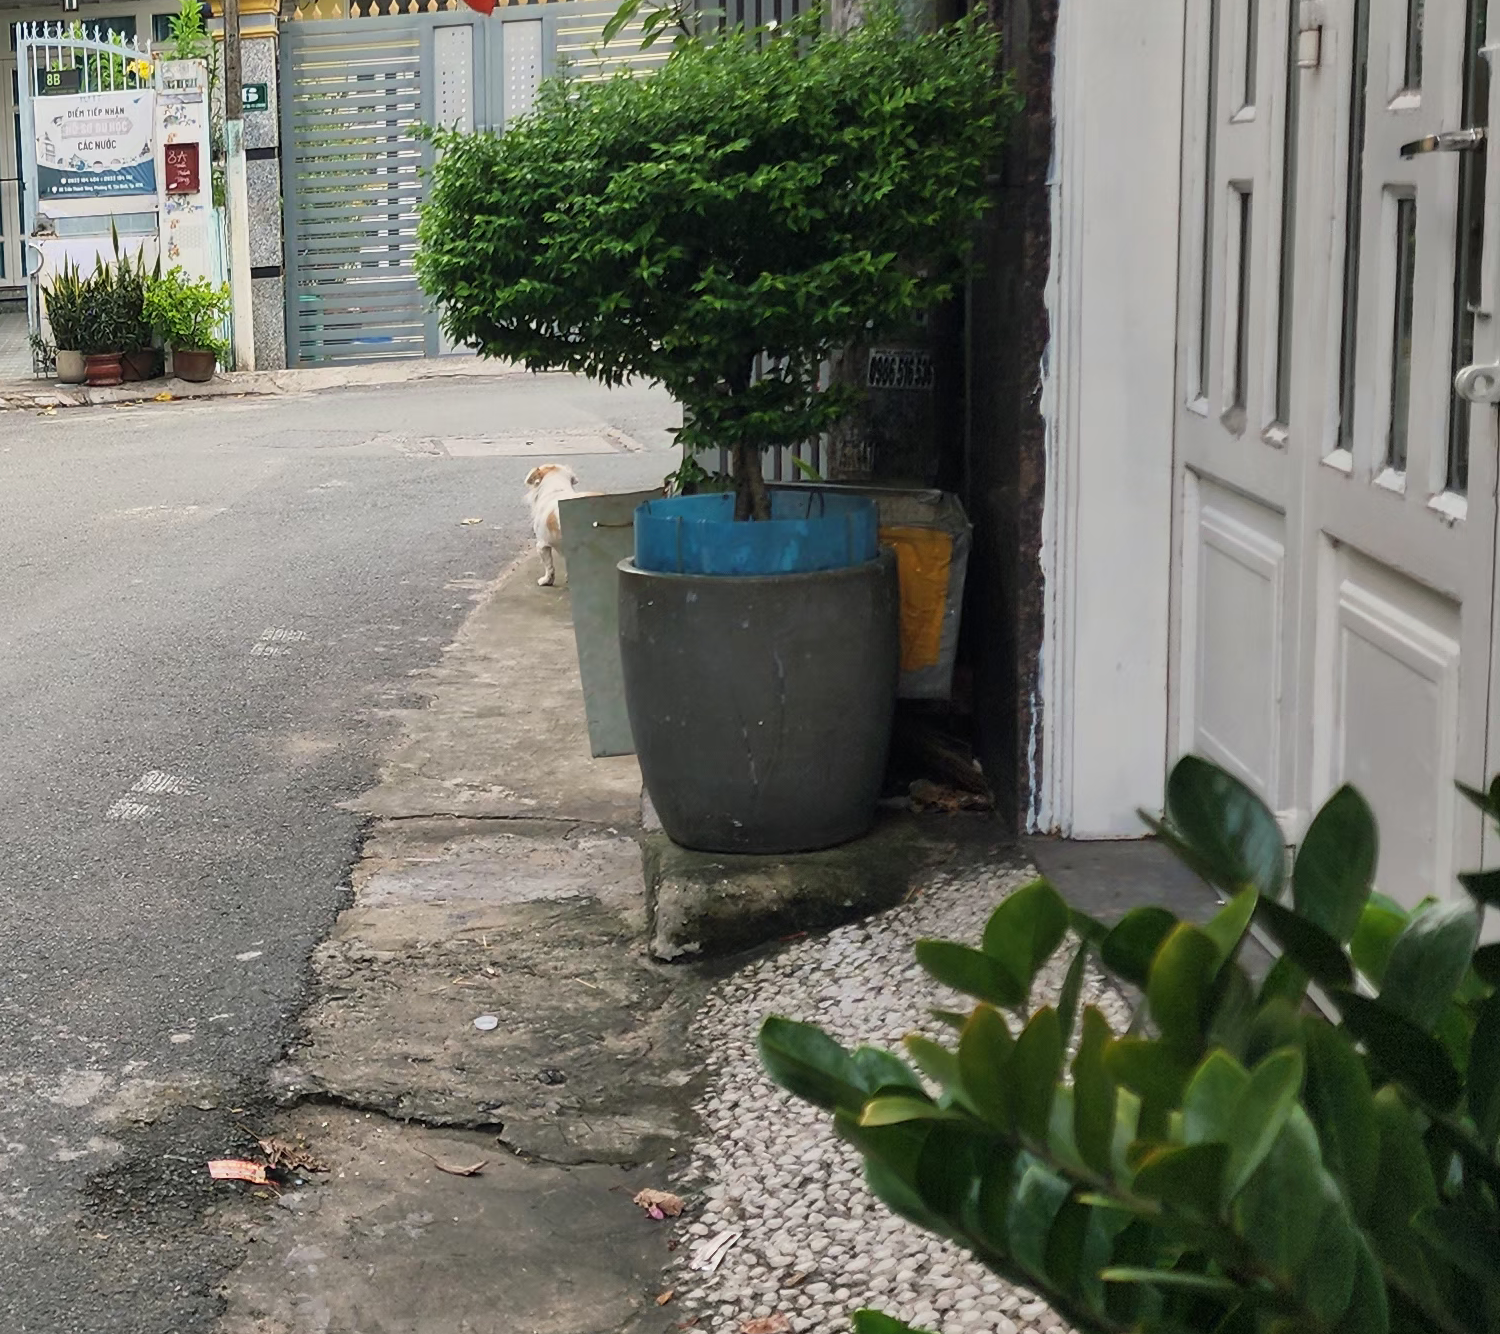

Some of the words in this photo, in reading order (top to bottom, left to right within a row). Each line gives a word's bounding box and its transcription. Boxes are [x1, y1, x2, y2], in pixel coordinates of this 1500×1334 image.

[47, 74, 61, 86] 8B
[78, 140, 93, 151] CÁC
[96, 139, 117, 150] NƯỚC
